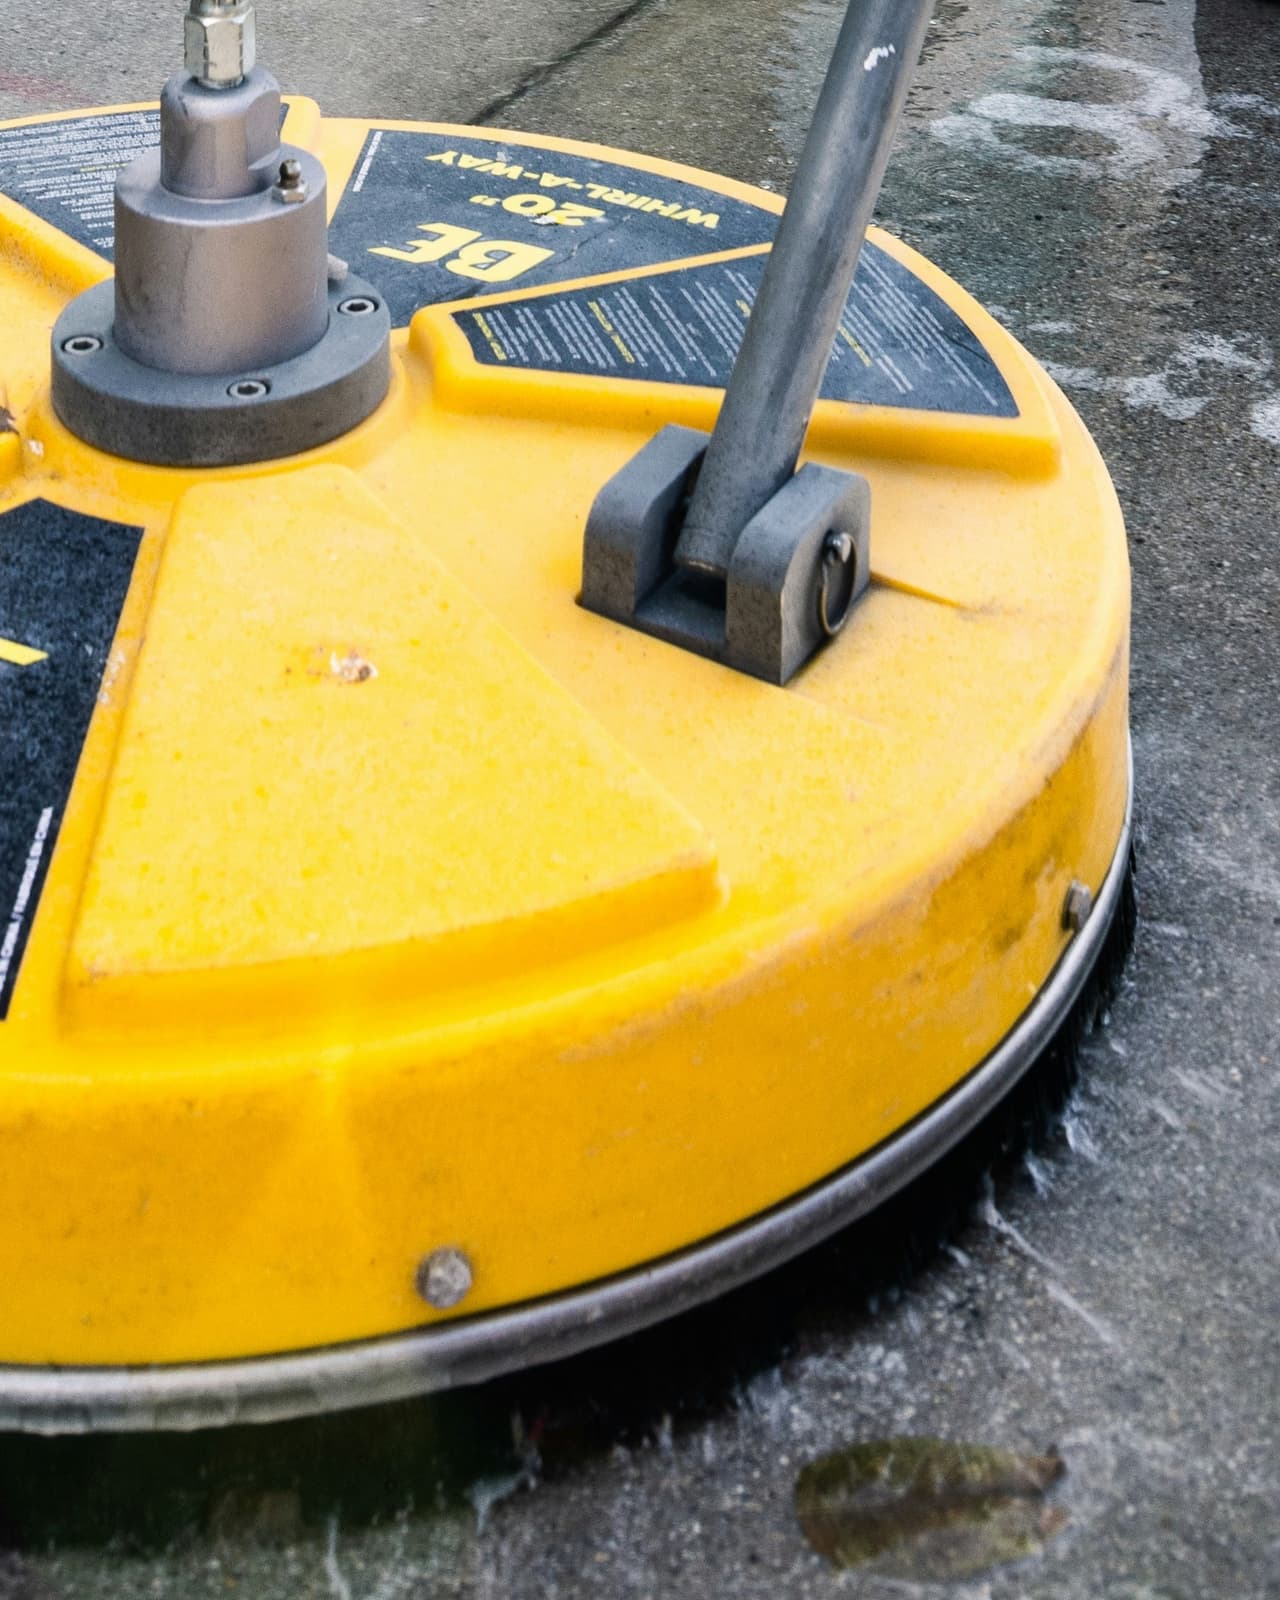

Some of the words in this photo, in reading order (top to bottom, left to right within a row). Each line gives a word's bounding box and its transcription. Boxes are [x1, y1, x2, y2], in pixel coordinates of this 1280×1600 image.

[425, 150, 721, 230] WHIRL-A-WAY
[366, 221, 557, 284] BE
[0, 921, 21, 957] CHINA
